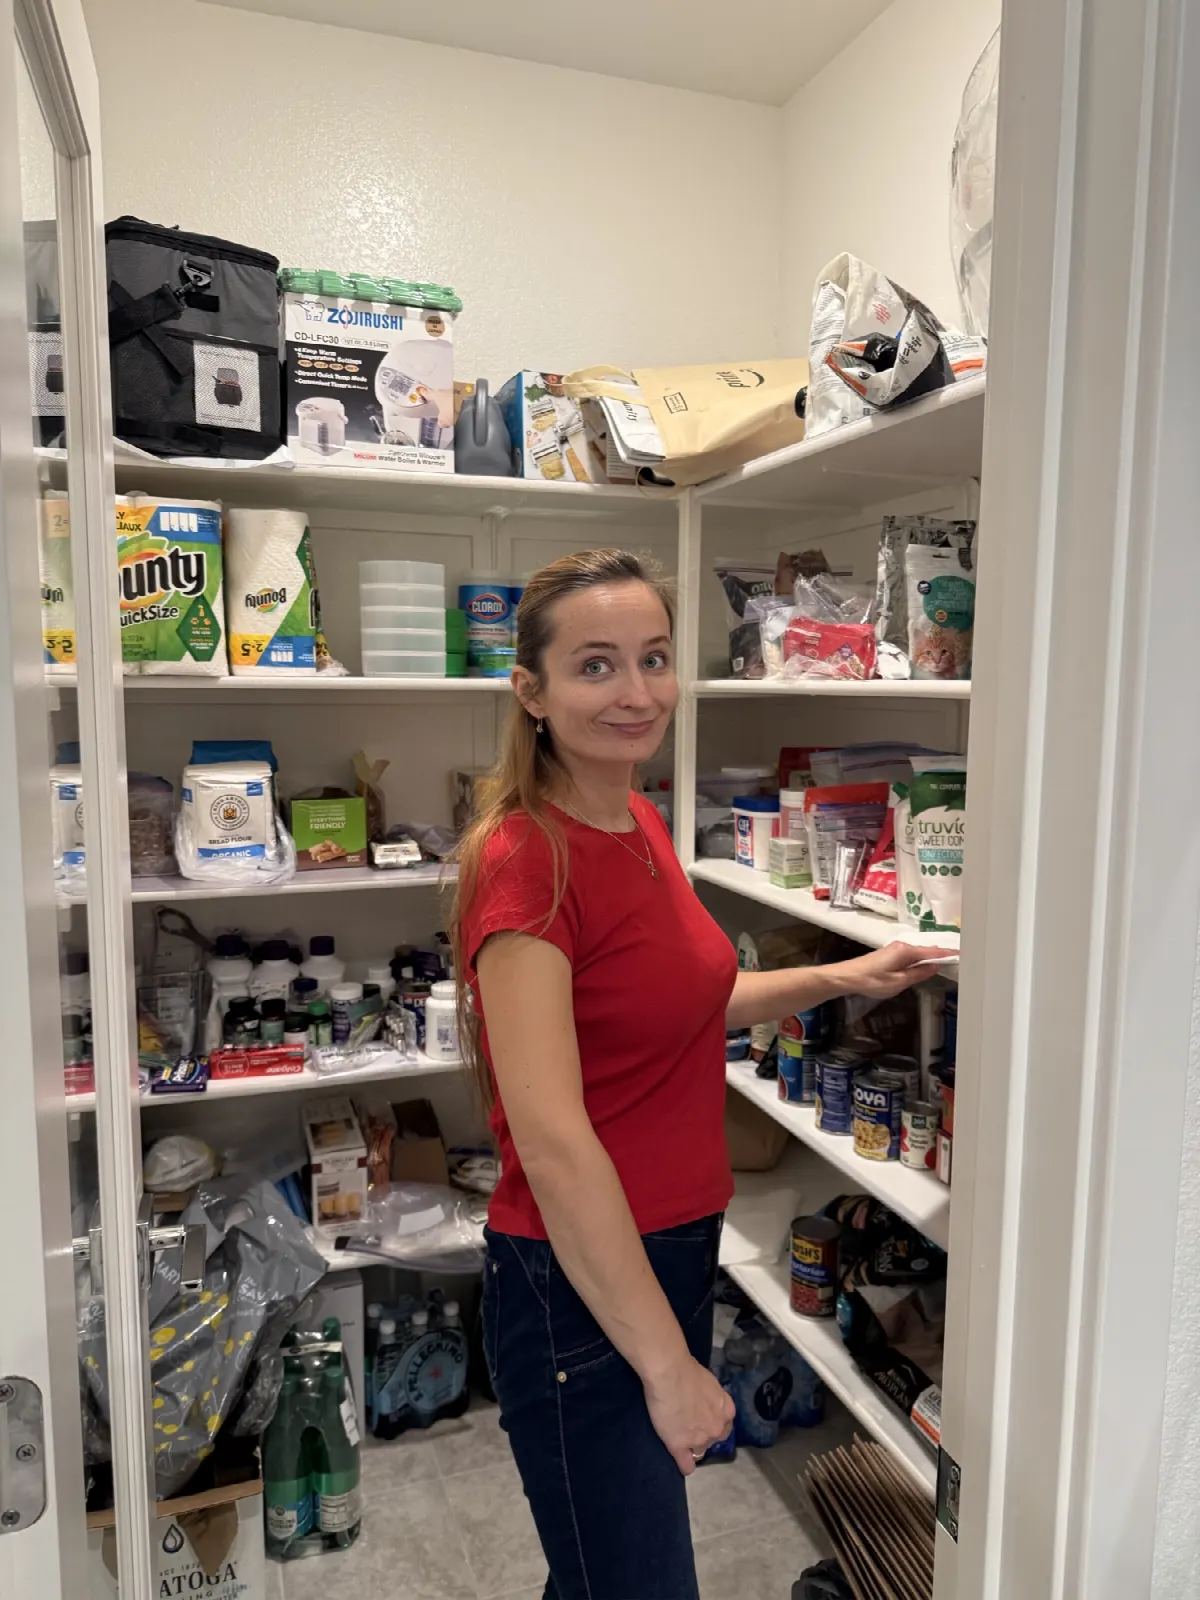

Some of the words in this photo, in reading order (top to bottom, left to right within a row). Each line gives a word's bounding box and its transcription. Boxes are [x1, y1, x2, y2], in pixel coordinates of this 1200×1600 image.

[327, 306, 403, 331] ZOJIRUSHI
[294, 332, 339, 345] CD-LFC30
[119, 547, 205, 601] unty
[245, 587, 287, 609] Bounty
[471, 601, 503, 613] CLOROX
[120, 604, 179, 627] uickSize
[309, 822, 346, 830] FRIENDLY
[208, 837, 230, 845] BREAD
[265, 1065, 302, 1074] Colgate
[854, 1087, 886, 1107] OYA
[160, 1562, 237, 1598] ATOGA
